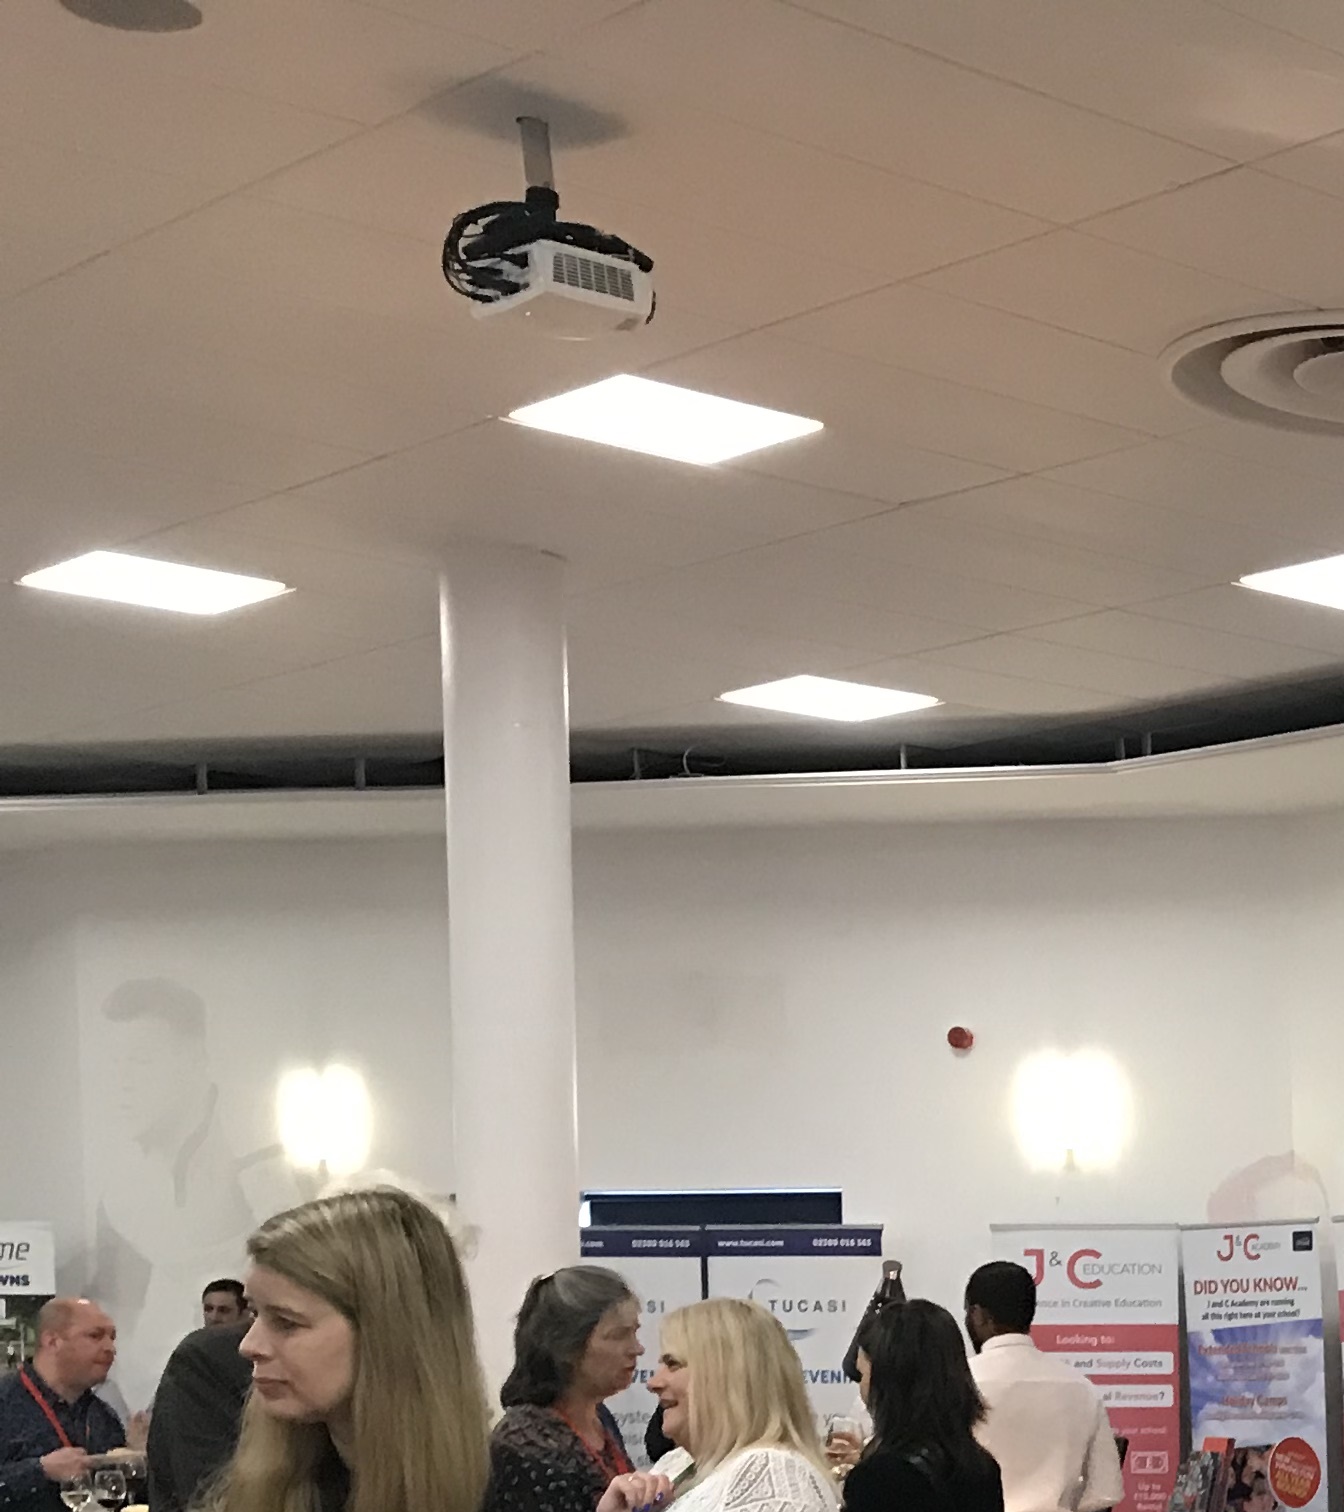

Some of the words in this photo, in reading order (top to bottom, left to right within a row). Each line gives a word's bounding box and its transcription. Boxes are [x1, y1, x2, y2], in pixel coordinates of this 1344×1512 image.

[1083, 1263, 1162, 1275] EDUCATION
[1193, 1280, 1218, 1295] DID
[1220, 1279, 1250, 1293] YOU
[768, 1300, 847, 1312] TUCASI
[1056, 1335, 1097, 1346] Looking
[1074, 1359, 1093, 1368] and
[1133, 1358, 1163, 1368] Costs
